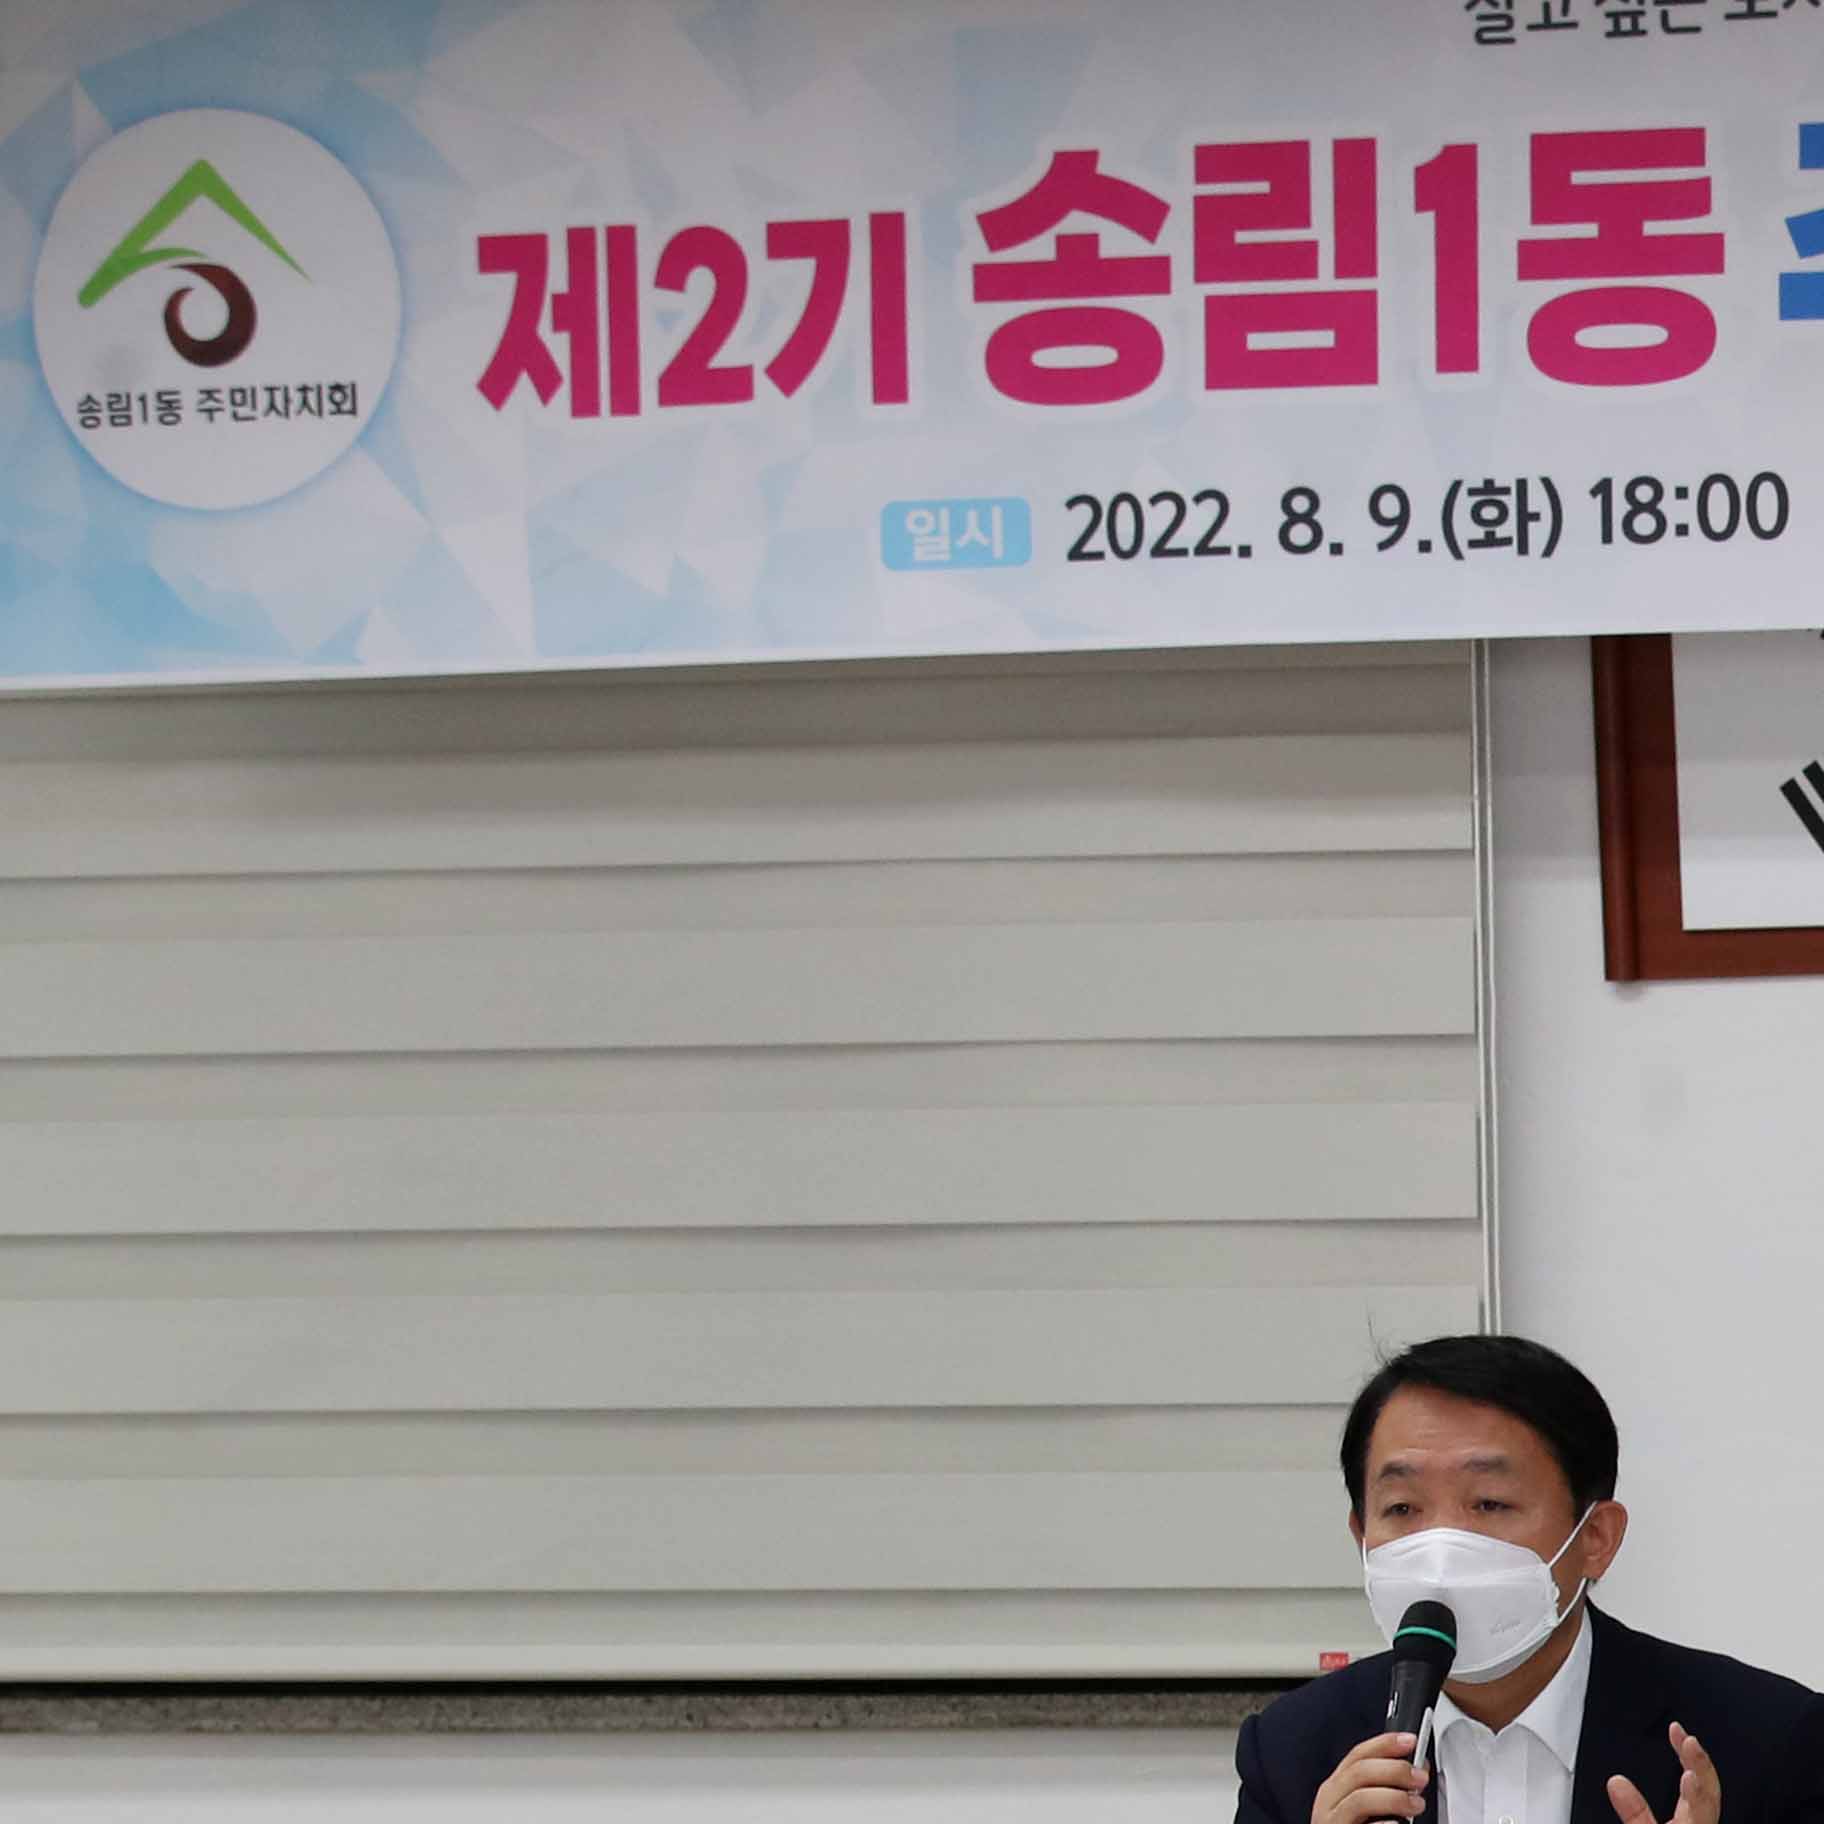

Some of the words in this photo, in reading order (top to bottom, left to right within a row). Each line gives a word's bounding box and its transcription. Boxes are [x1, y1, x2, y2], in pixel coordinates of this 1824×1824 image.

[478, 212, 908, 418] 제2기
[974, 127, 1725, 406] 송림1동
[77, 390, 183, 430] 송림1동
[196, 381, 358, 423] 주민자치회
[905, 504, 1005, 562] 일시
[1065, 489, 1252, 562] 2022.
[1278, 486, 1344, 556] 8.
[1368, 476, 1563, 561] 9.(화)
[1589, 471, 1789, 545] 18:00
